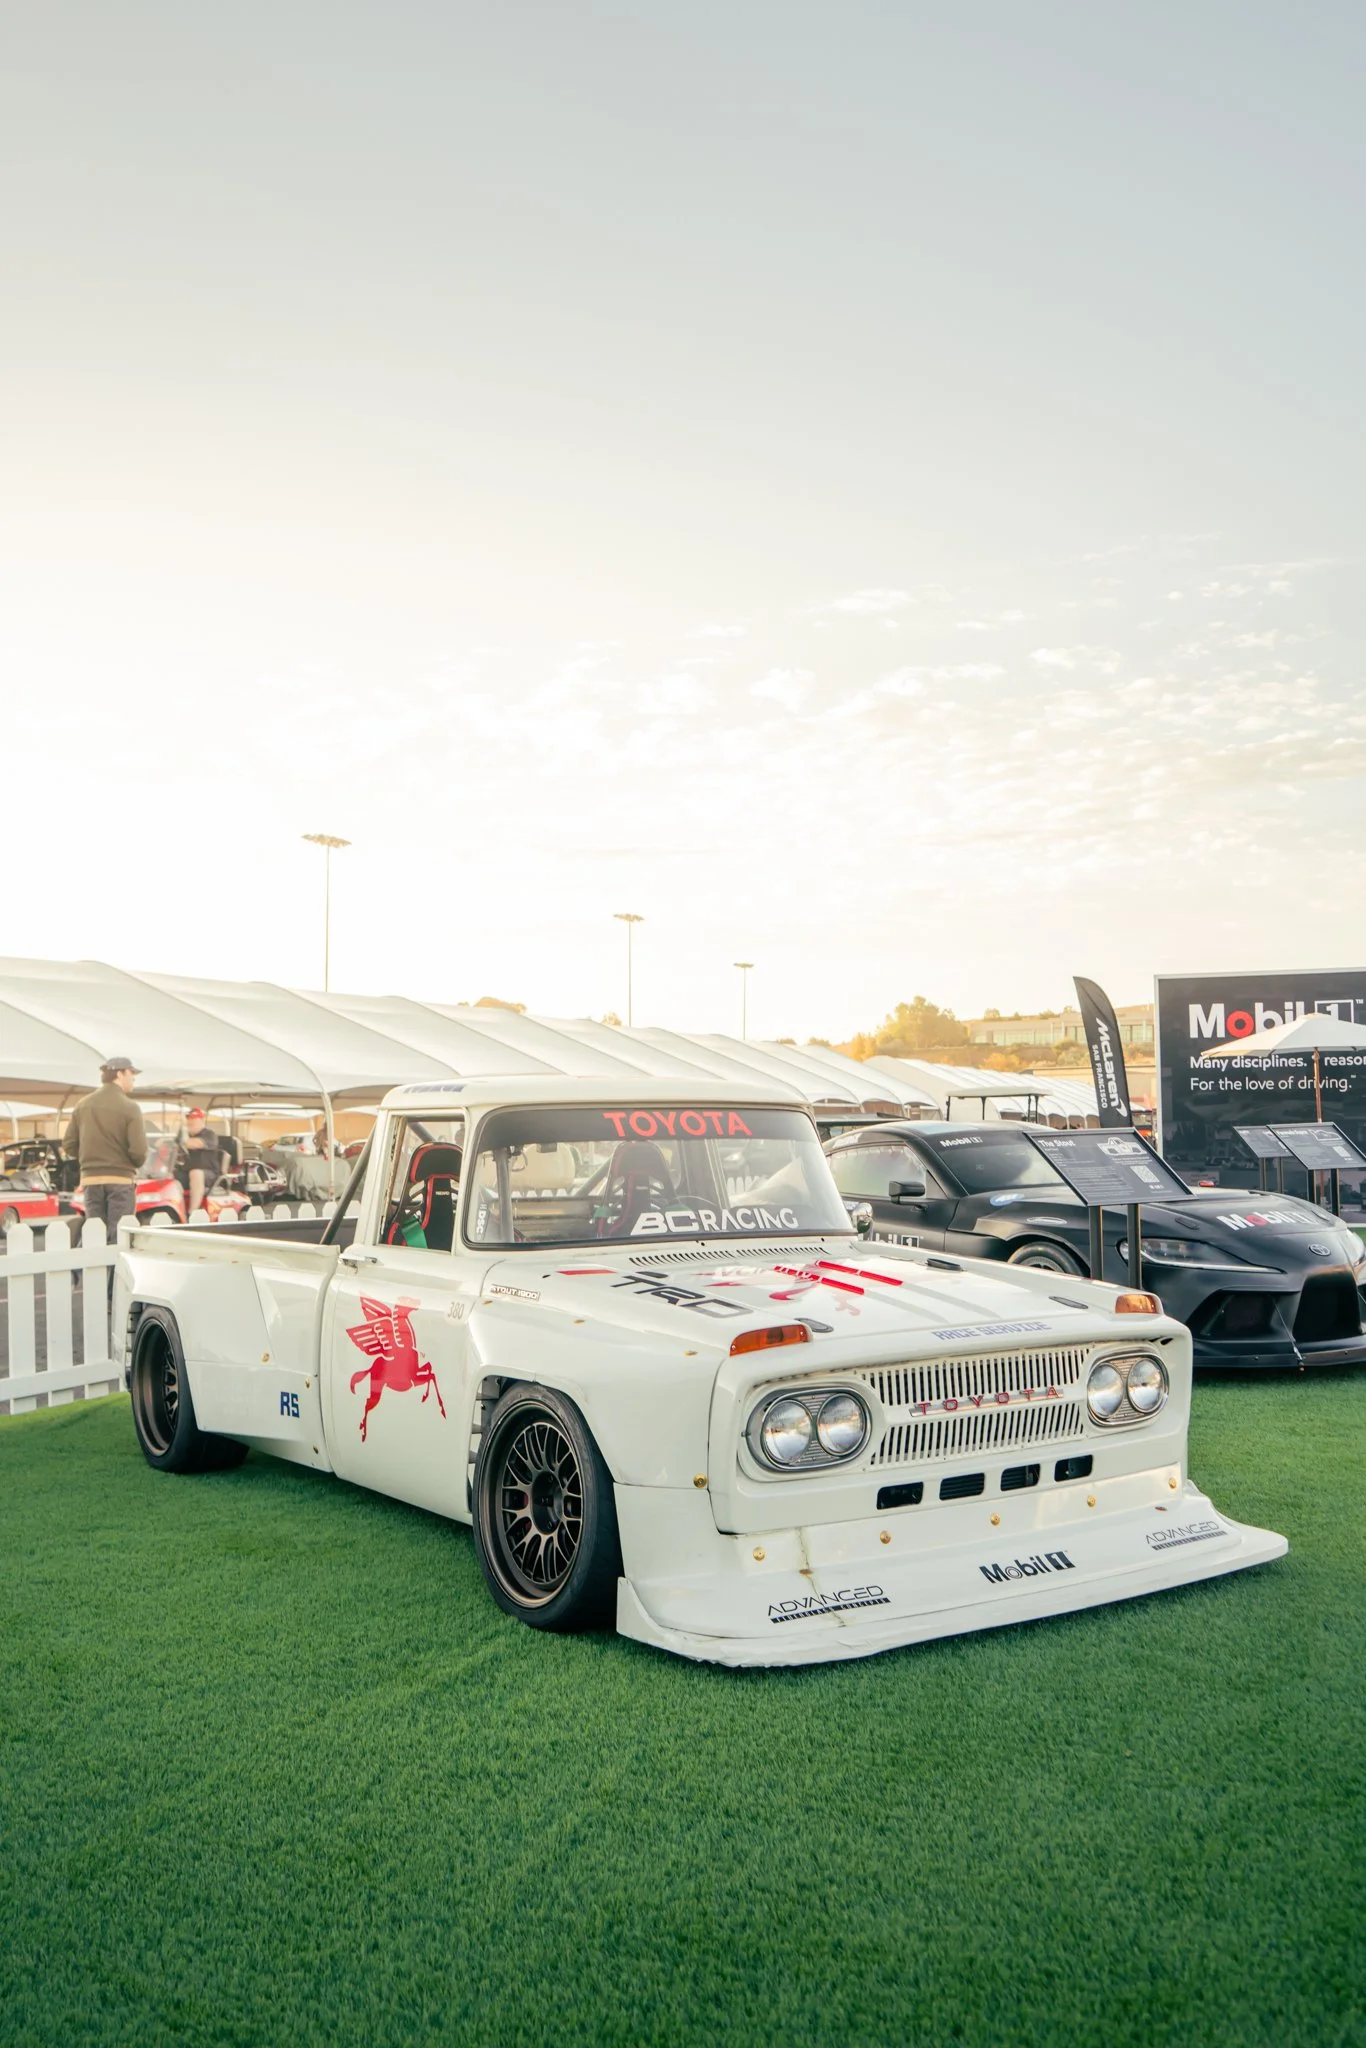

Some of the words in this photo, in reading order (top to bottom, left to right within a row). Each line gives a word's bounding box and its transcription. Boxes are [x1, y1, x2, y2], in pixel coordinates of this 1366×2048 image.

[1091, 1044, 1100, 1062] SAN
[1095, 1017, 1120, 1109] McLaren
[1190, 1055, 1229, 1073] Many
[1231, 1055, 1308, 1072] disciplines.
[1095, 1062, 1108, 1109] FRANCISCO
[1190, 1077, 1215, 1091] For
[1219, 1076, 1243, 1091] the
[1245, 1076, 1275, 1091] love
[1278, 1075, 1295, 1090] of
[603, 1109, 753, 1138] TOYOTA
[939, 1136, 972, 1148] Mobil
[1216, 1210, 1298, 1231] Mobil
[610, 1270, 754, 1319] TRD
[447, 1301, 465, 1320] 380
[931, 1327, 977, 1341] RACE
[977, 1321, 1053, 1337] SERVICE
[280, 1391, 300, 1418] RS
[915, 1385, 1060, 1415] TOYOTA
[1145, 1520, 1220, 1545] ADVANCED
[979, 1554, 1051, 1584] Mobil
[767, 1585, 884, 1617] ADVANCED
